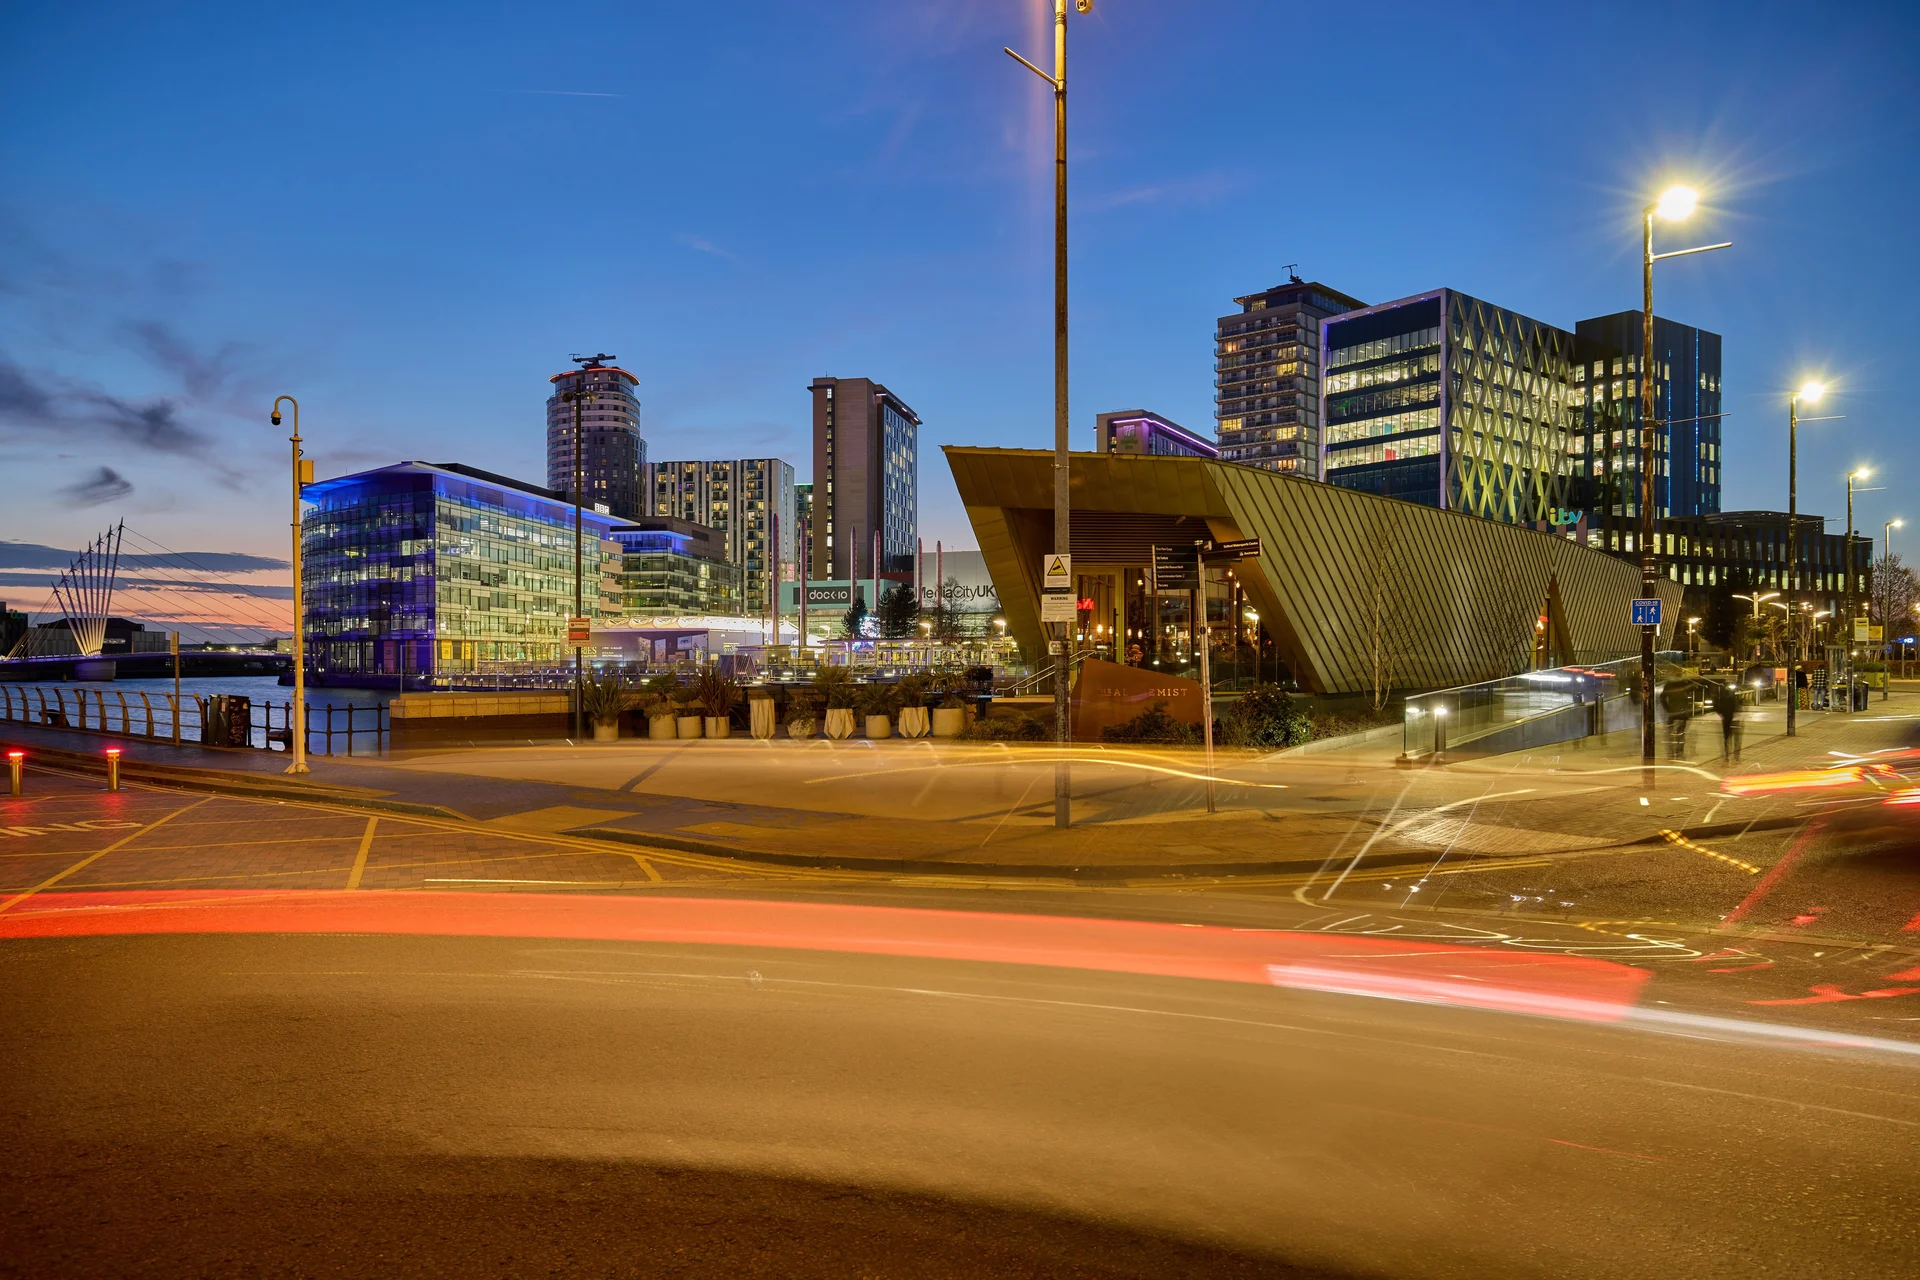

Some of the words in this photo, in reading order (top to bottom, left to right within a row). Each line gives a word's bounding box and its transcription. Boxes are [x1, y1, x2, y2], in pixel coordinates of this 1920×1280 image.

[594, 502, 610, 515] BBC
[1549, 507, 1583, 526] itv
[915, 585, 996, 601] MeiaCityUK
[564, 646, 598, 655] STRIES
[1113, 688, 1188, 697] ALEMIST
